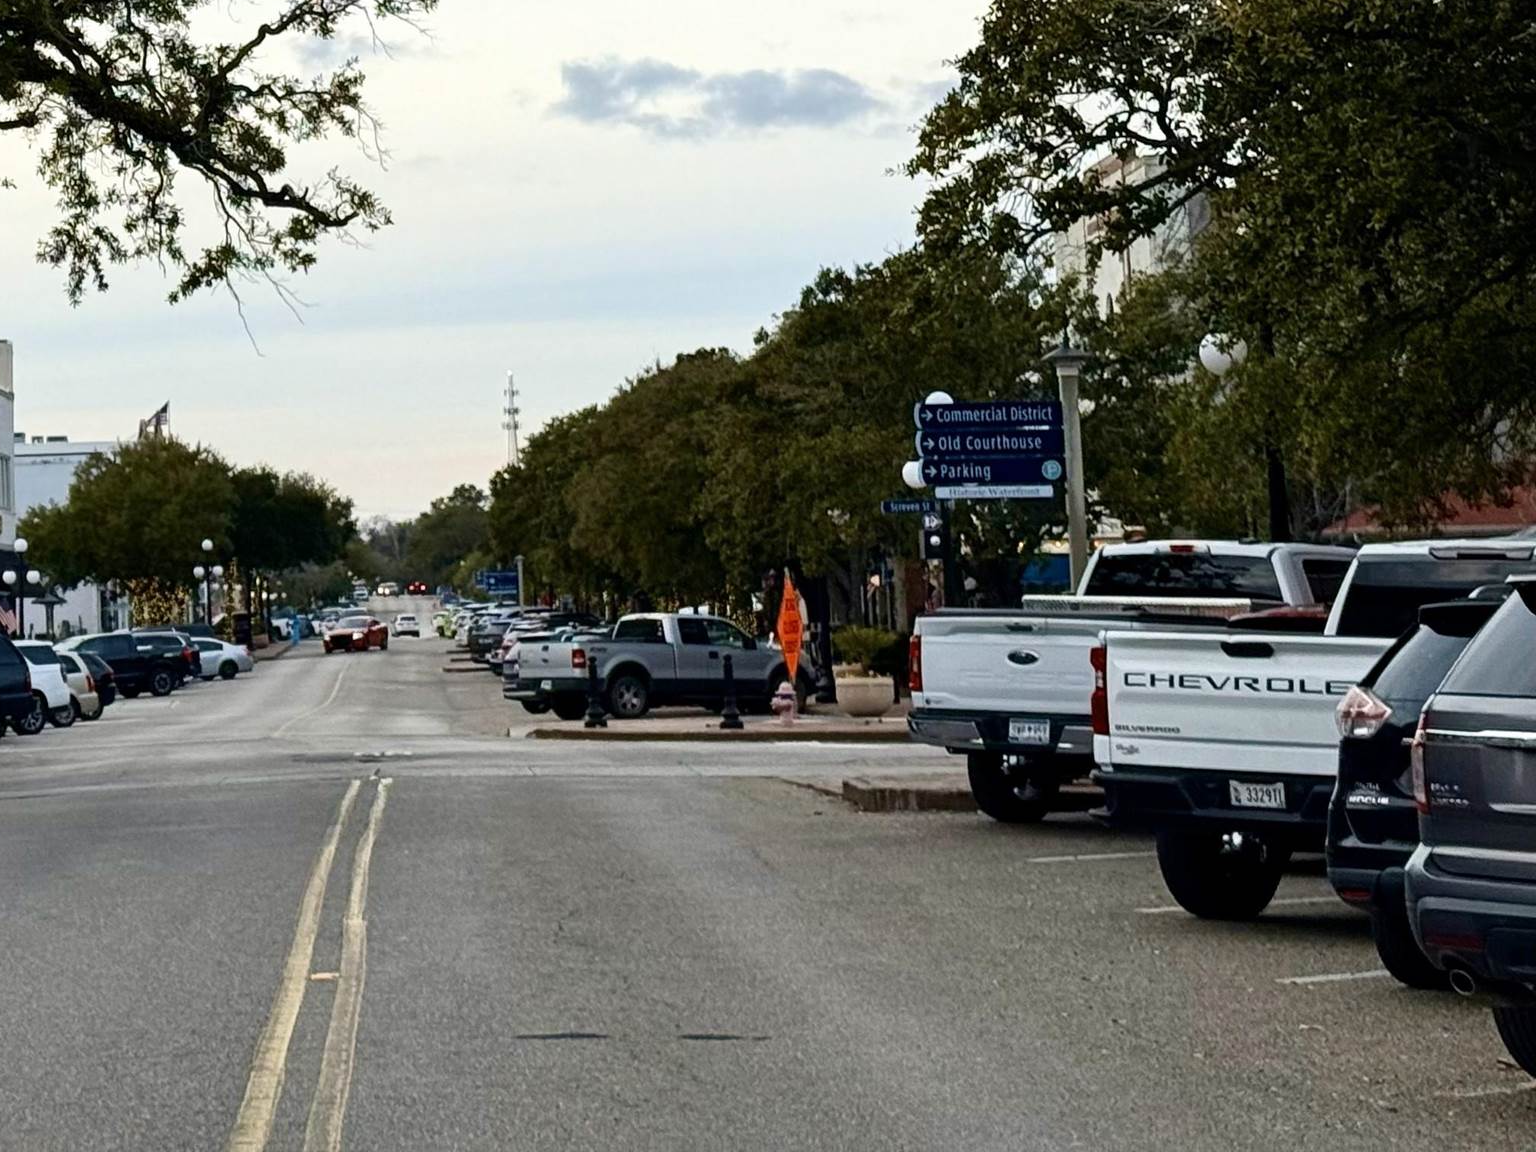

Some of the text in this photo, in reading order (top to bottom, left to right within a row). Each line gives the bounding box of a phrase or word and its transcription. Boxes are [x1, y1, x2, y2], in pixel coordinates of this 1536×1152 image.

[936, 405, 1053, 423] Commercial District
[938, 434, 1043, 451] Old Courthouse
[940, 462, 991, 481] Parking
[890, 502, 920, 513] Screven
[1123, 672, 1358, 696] CHEVROLE
[1115, 724, 1181, 734] SILVERADO
